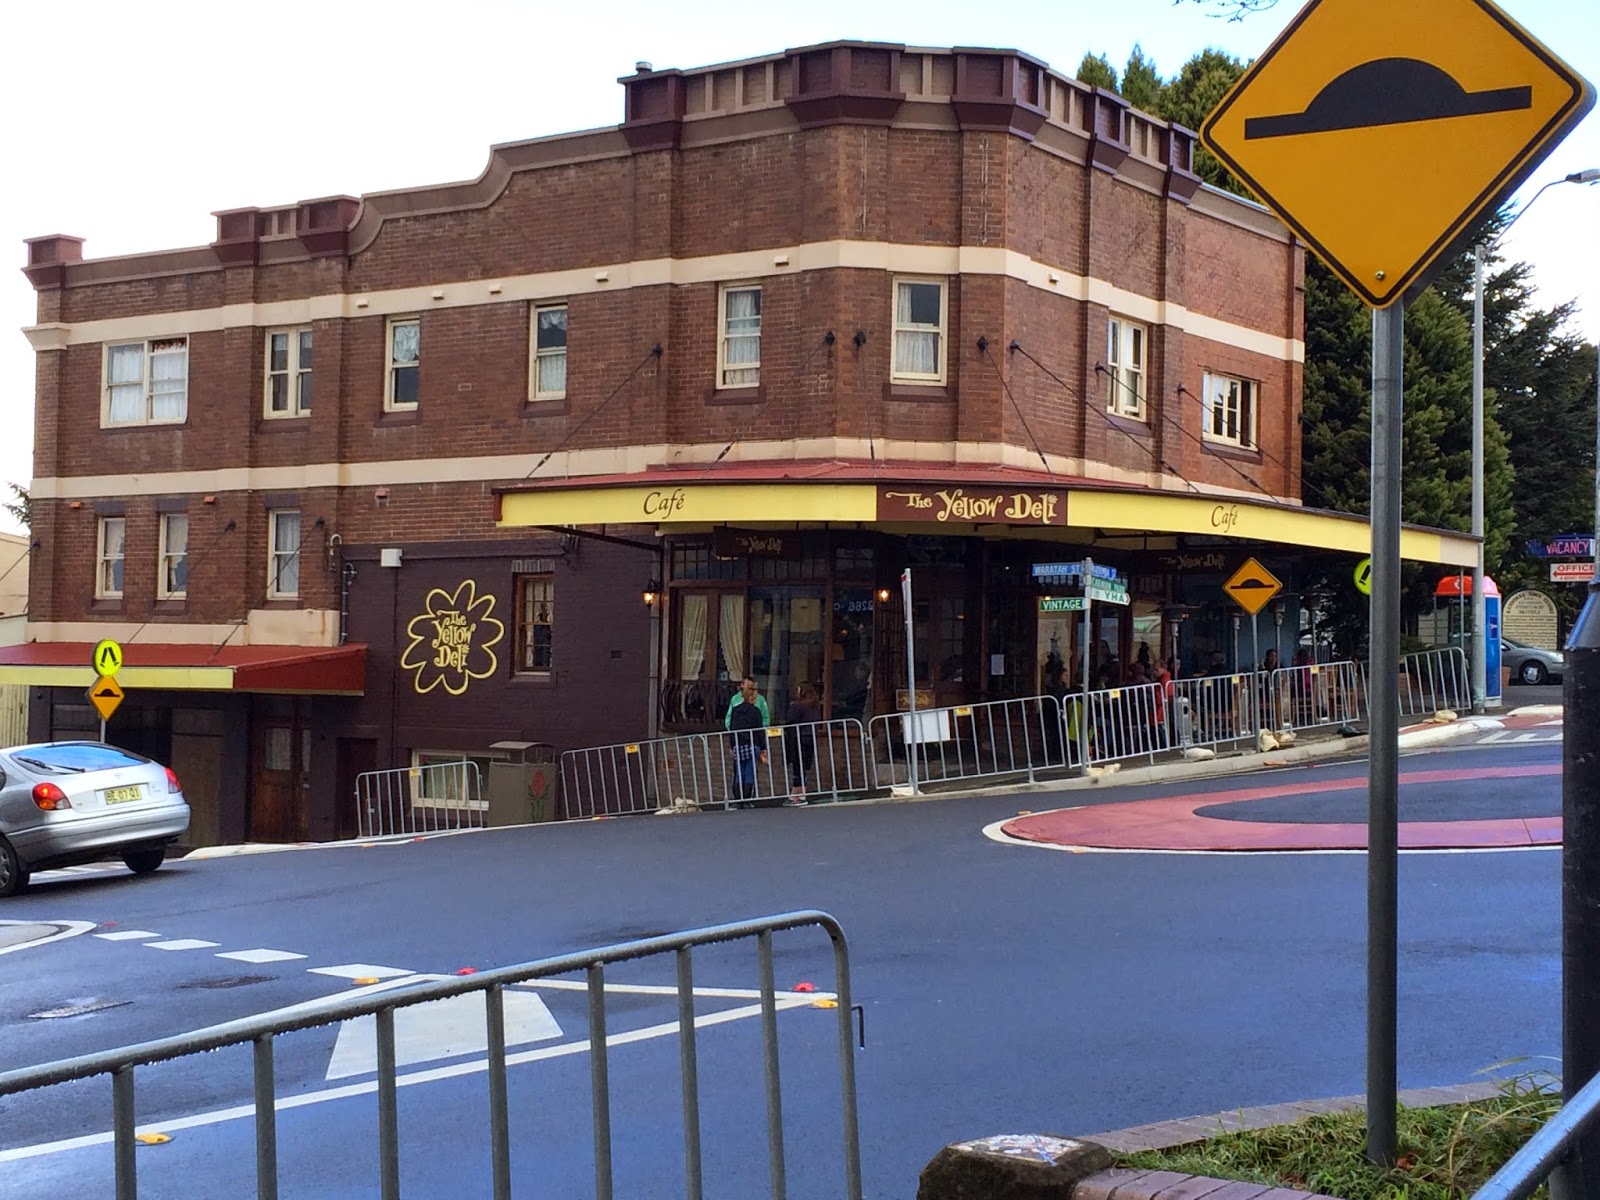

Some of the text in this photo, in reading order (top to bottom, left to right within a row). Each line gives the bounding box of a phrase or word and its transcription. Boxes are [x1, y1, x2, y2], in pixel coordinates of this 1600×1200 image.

[643, 488, 685, 519] Café
[885, 488, 1058, 524] The Yellow Deli
[1211, 505, 1238, 533] Café
[1546, 541, 1589, 554] VACANCY
[1033, 564, 1080, 576] WARATAH ST
[1557, 564, 1596, 572] OFFICE
[1042, 599, 1081, 610] VINTAGE
[1105, 591, 1125, 603] YHA
[437, 610, 467, 625] The
[431, 617, 477, 649] Yellow
[434, 644, 470, 673] Deli
